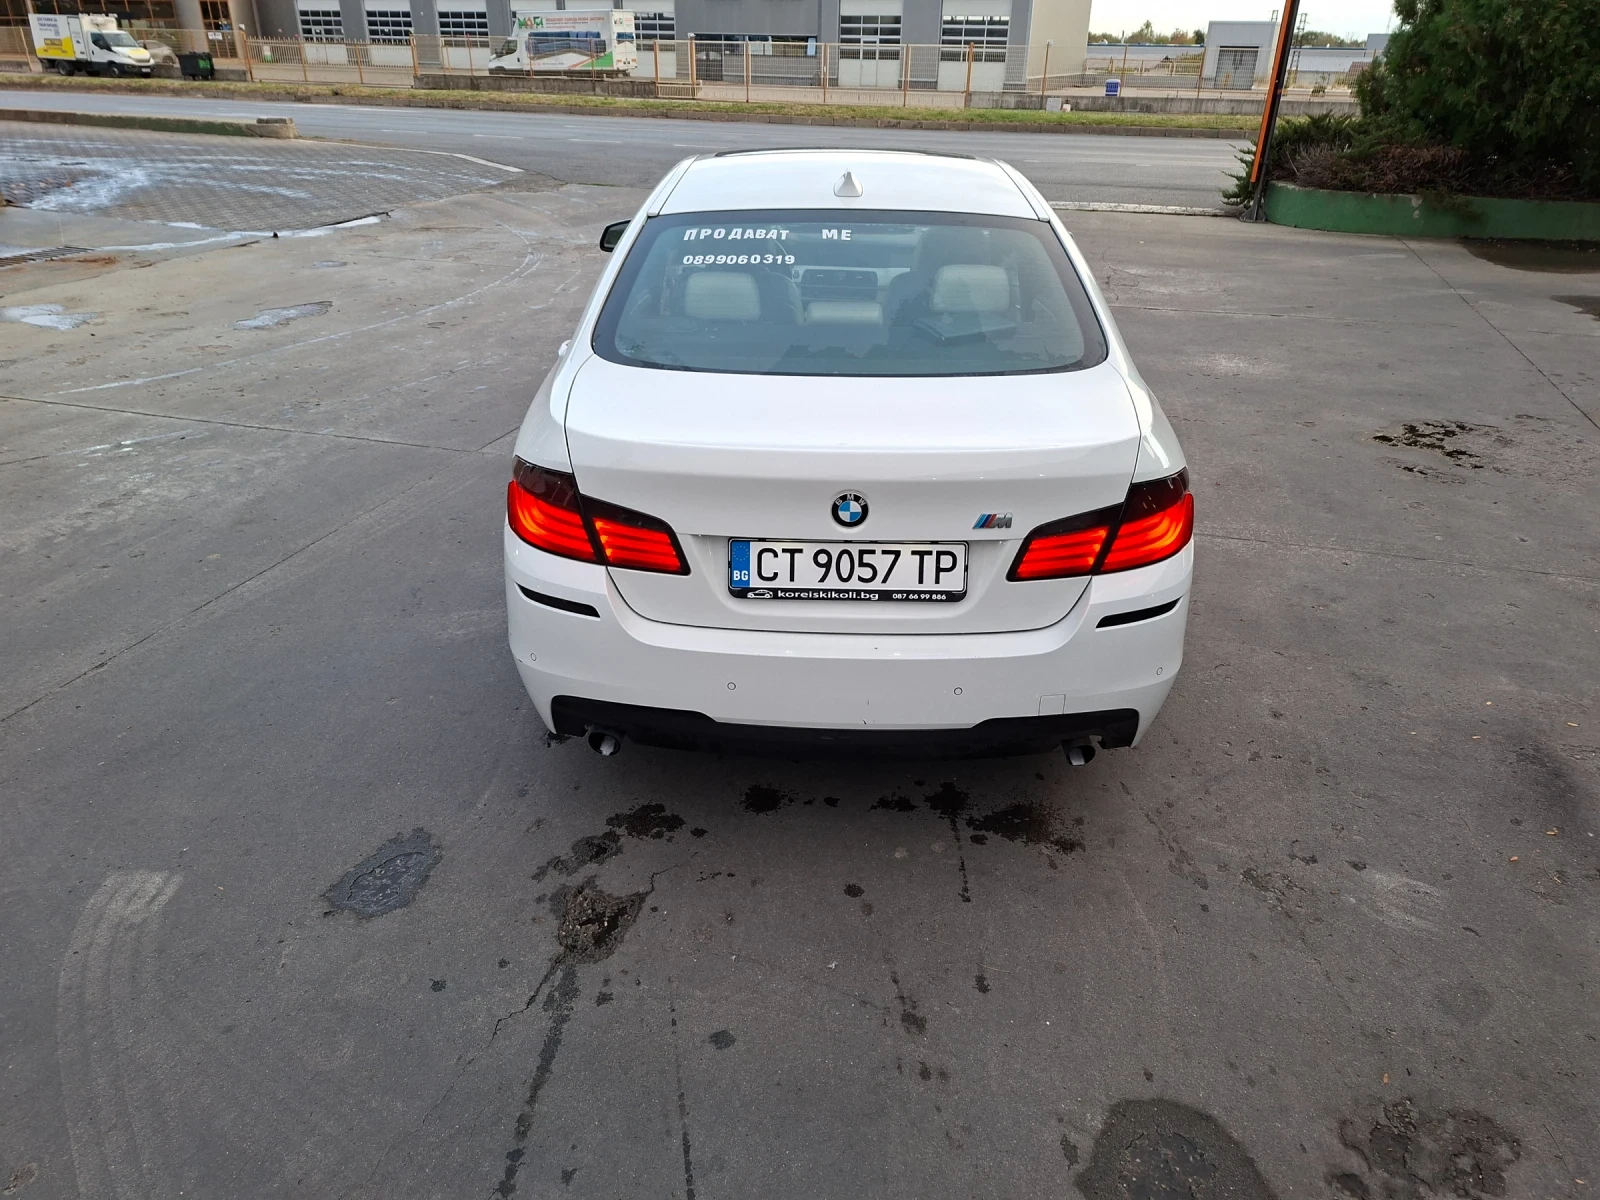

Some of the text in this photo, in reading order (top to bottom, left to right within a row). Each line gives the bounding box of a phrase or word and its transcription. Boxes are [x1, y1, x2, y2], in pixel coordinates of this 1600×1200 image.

[683, 228, 852, 241] ПРОДАВАТ МЕ
[682, 254, 796, 265] 0899060319
[757, 547, 958, 585] CT 9057 TP
[733, 570, 748, 581] BG
[778, 590, 879, 600] koreiskikoli.bg
